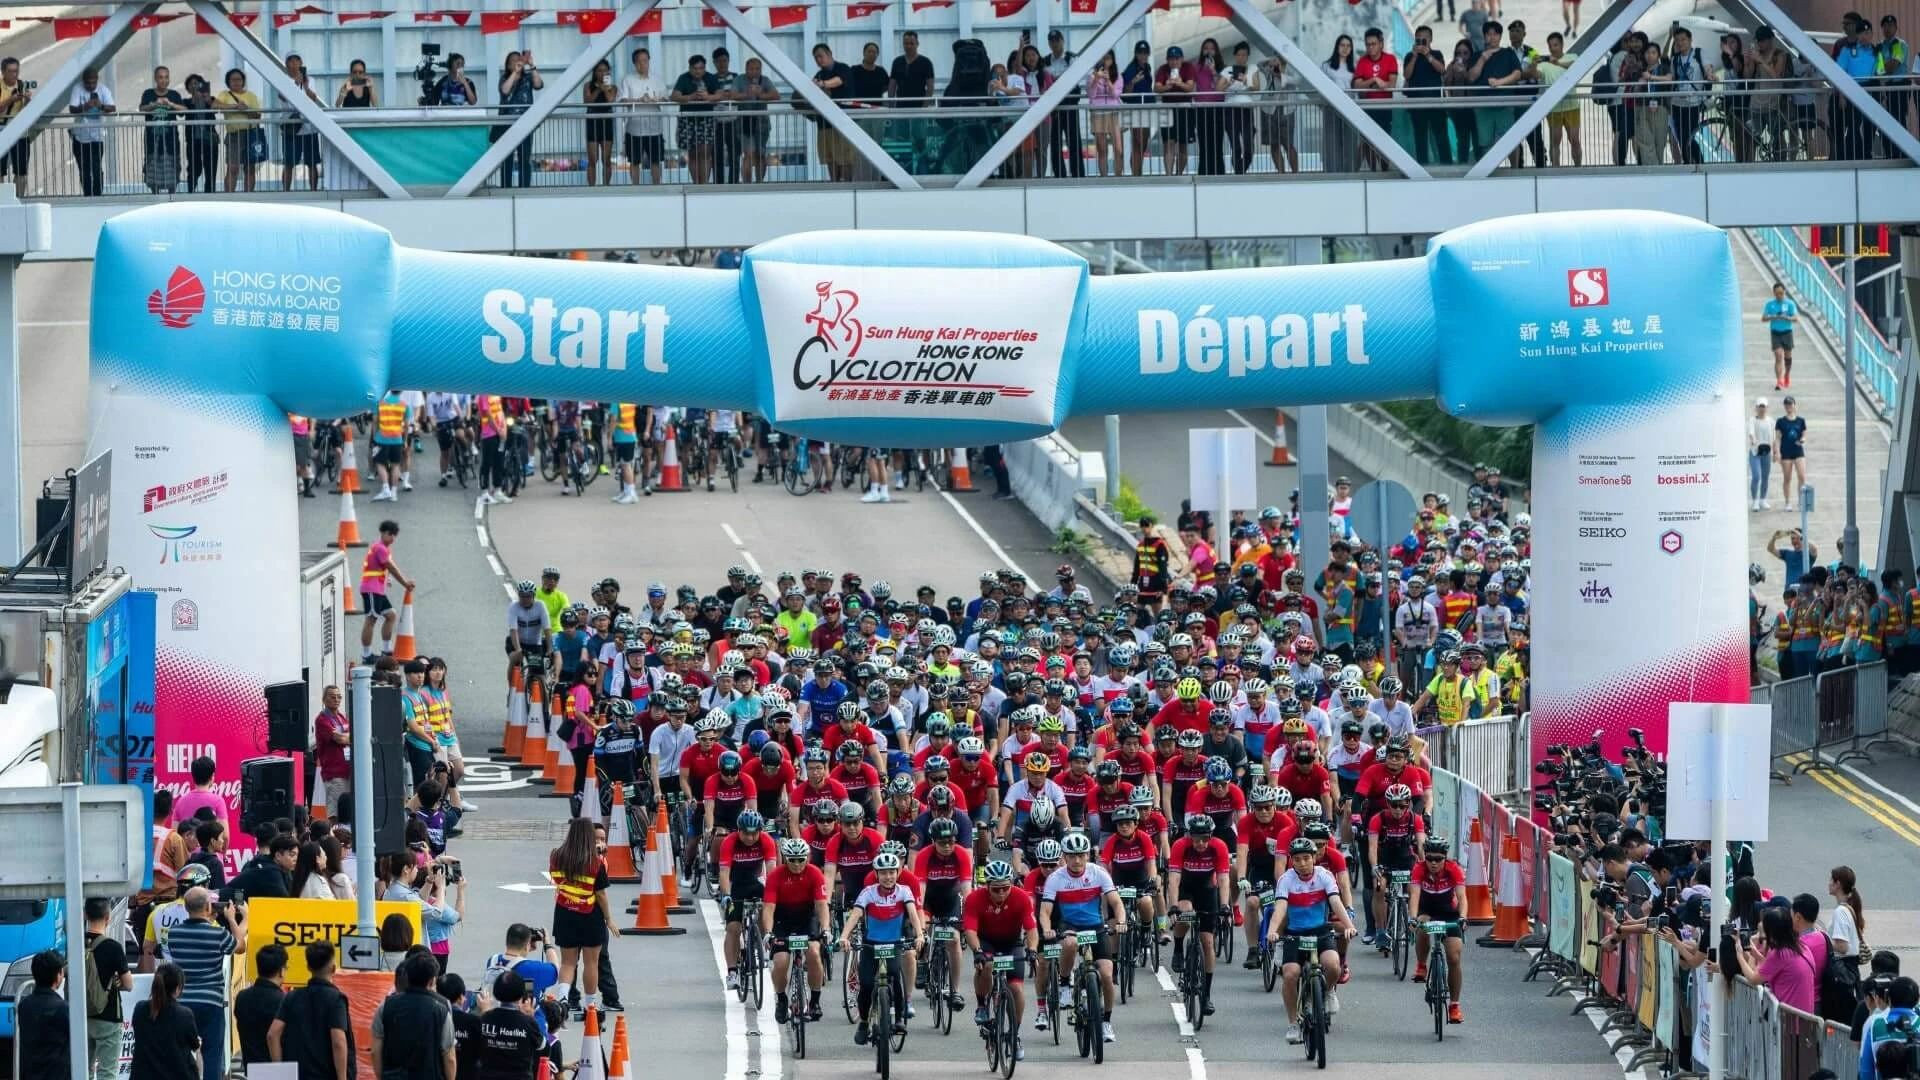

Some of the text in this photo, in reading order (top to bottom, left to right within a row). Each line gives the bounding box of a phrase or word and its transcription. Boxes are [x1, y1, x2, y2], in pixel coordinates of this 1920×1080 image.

[212, 270, 342, 294] HONG KONG
[212, 290, 341, 311] TOURISM BOARD
[211, 307, 340, 333] 香港旅遊發展局
[1519, 314, 1664, 341] 新鴻基地產
[481, 288, 671, 373] Start
[865, 327, 1038, 344] Sun Hung Kai Properties
[1137, 303, 1370, 377] Départ
[917, 345, 1024, 361] HONG KONG
[1519, 340, 1664, 358] Sun Hung Kai Properties
[904, 389, 994, 406] 香港單車節
[1579, 475, 1620, 485] SmarTone
[1657, 472, 1710, 485] bossini.X
[1579, 527, 1627, 538] SEIKO
[1579, 579, 1613, 599] vita
[274, 922, 381, 947] SEIK
